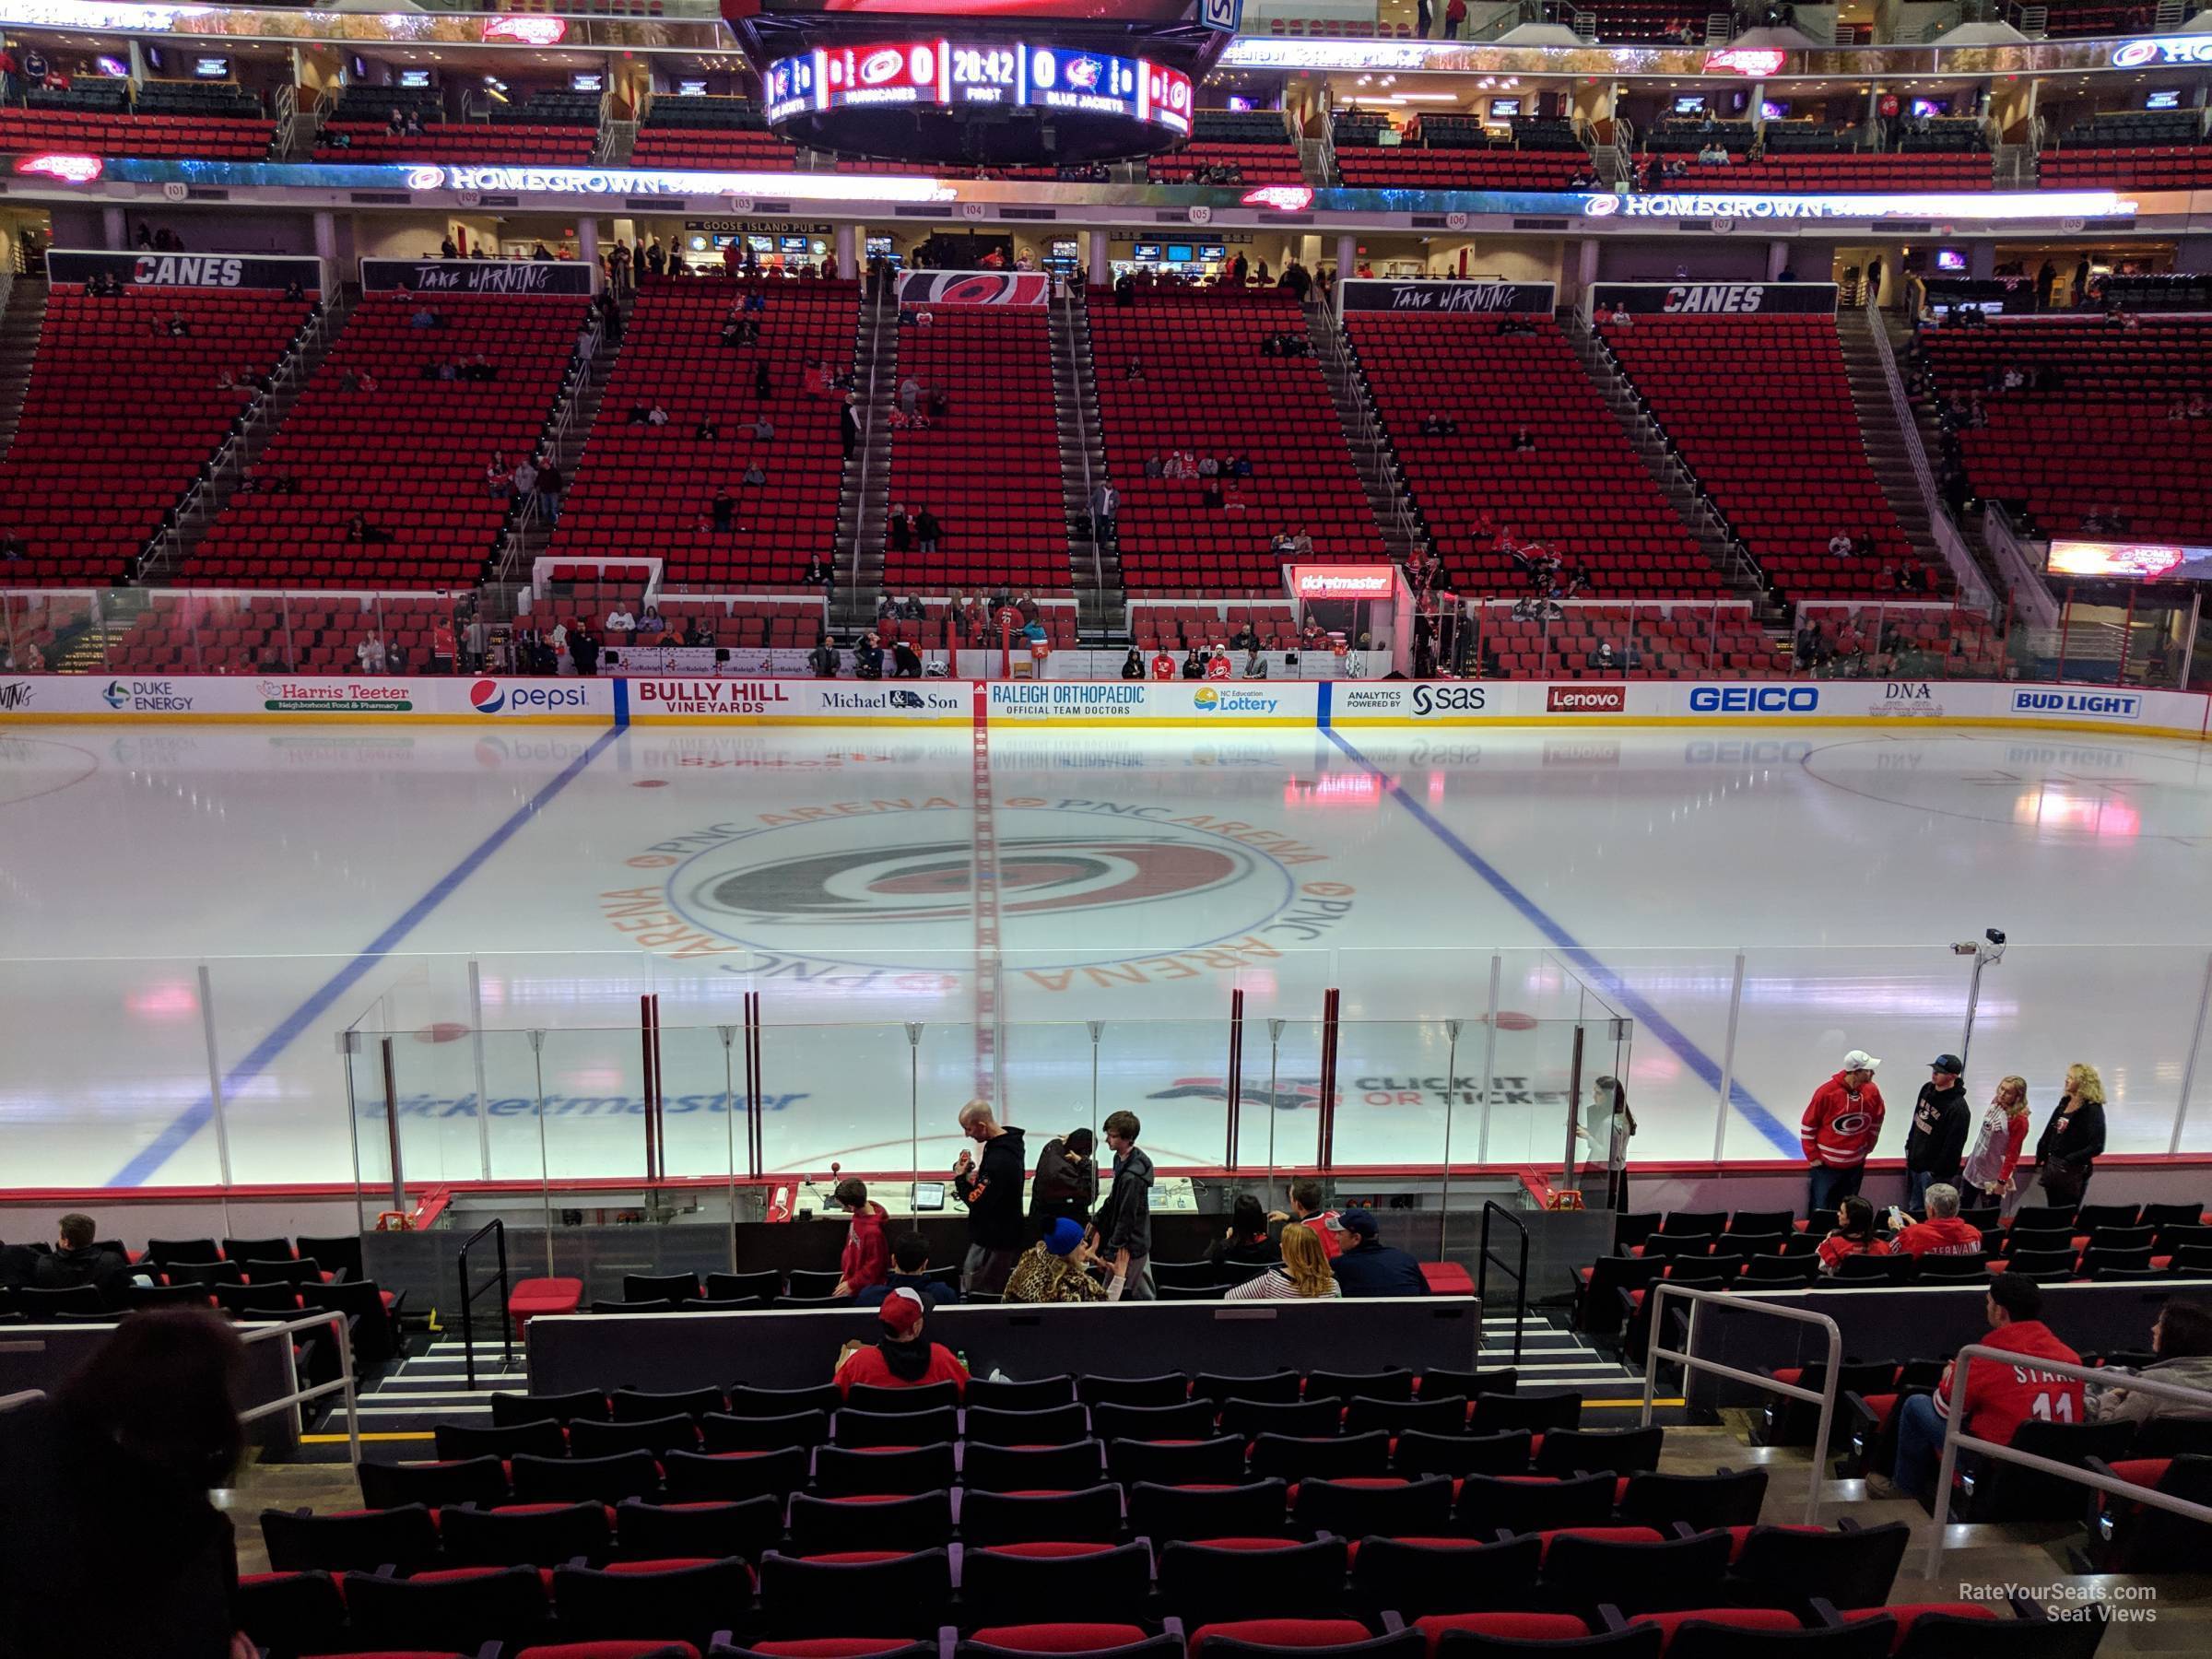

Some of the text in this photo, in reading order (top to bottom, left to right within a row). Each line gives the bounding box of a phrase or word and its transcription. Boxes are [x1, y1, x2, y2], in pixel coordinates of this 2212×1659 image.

[912, 46, 934, 84] 0
[951, 50, 1014, 82] 20:42
[1033, 50, 1055, 87] 0
[967, 87, 1002, 100] FIRST
[1047, 89, 1124, 112] BLUE JACKETS
[452, 167, 659, 193] HOMEGROWN
[168, 185, 184, 196] 101
[966, 205, 982, 215] 104
[1192, 210, 1207, 219] 105
[1626, 194, 1825, 218] HOMEGROWN
[703, 220, 816, 233] GOOSE ISLAND PUB
[1449, 215, 1465, 225] 106
[134, 256, 243, 287] CANES
[415, 264, 553, 293] TAKE WARNING
[1392, 283, 1521, 312] TAKE WARNING
[1663, 286, 1764, 312] CANES
[134, 682, 172, 695] DUKE
[281, 684, 409, 700] Harris Teeter
[640, 682, 789, 700] BULLY HILL
[993, 686, 1145, 704] RALEIGH ORTHOPAEDIC
[1348, 691, 1401, 700] ANALYTICS
[1885, 683, 1932, 700] DNA
[135, 697, 194, 711] ENERGY
[279, 701, 330, 710] Neighborhood
[360, 701, 399, 711] Pharmacy
[512, 686, 586, 710] pepsi
[822, 691, 958, 709] Michael & Son
[1220, 697, 1277, 713] Lottery
[1553, 691, 1618, 706] Lenovo
[1689, 688, 1819, 712] GEICO
[2017, 693, 2136, 714] BUD LIGHT
[666, 702, 765, 713] VINEYARDS
[1006, 706, 1130, 715] OFFICIAL TEAM DOCTORS
[645, 795, 960, 854] PNC ARENA
[1055, 798, 1330, 865] PNC ARENA
[599, 885, 887, 984] PNC ARENA
[1022, 898, 1353, 992] PNC ARENA
[1355, 1076, 1527, 1091] CLICK IT
[1364, 1091, 1424, 1107] OR
[2013, 1365, 2077, 1383] STA
[2031, 1393, 2073, 1422] 11
